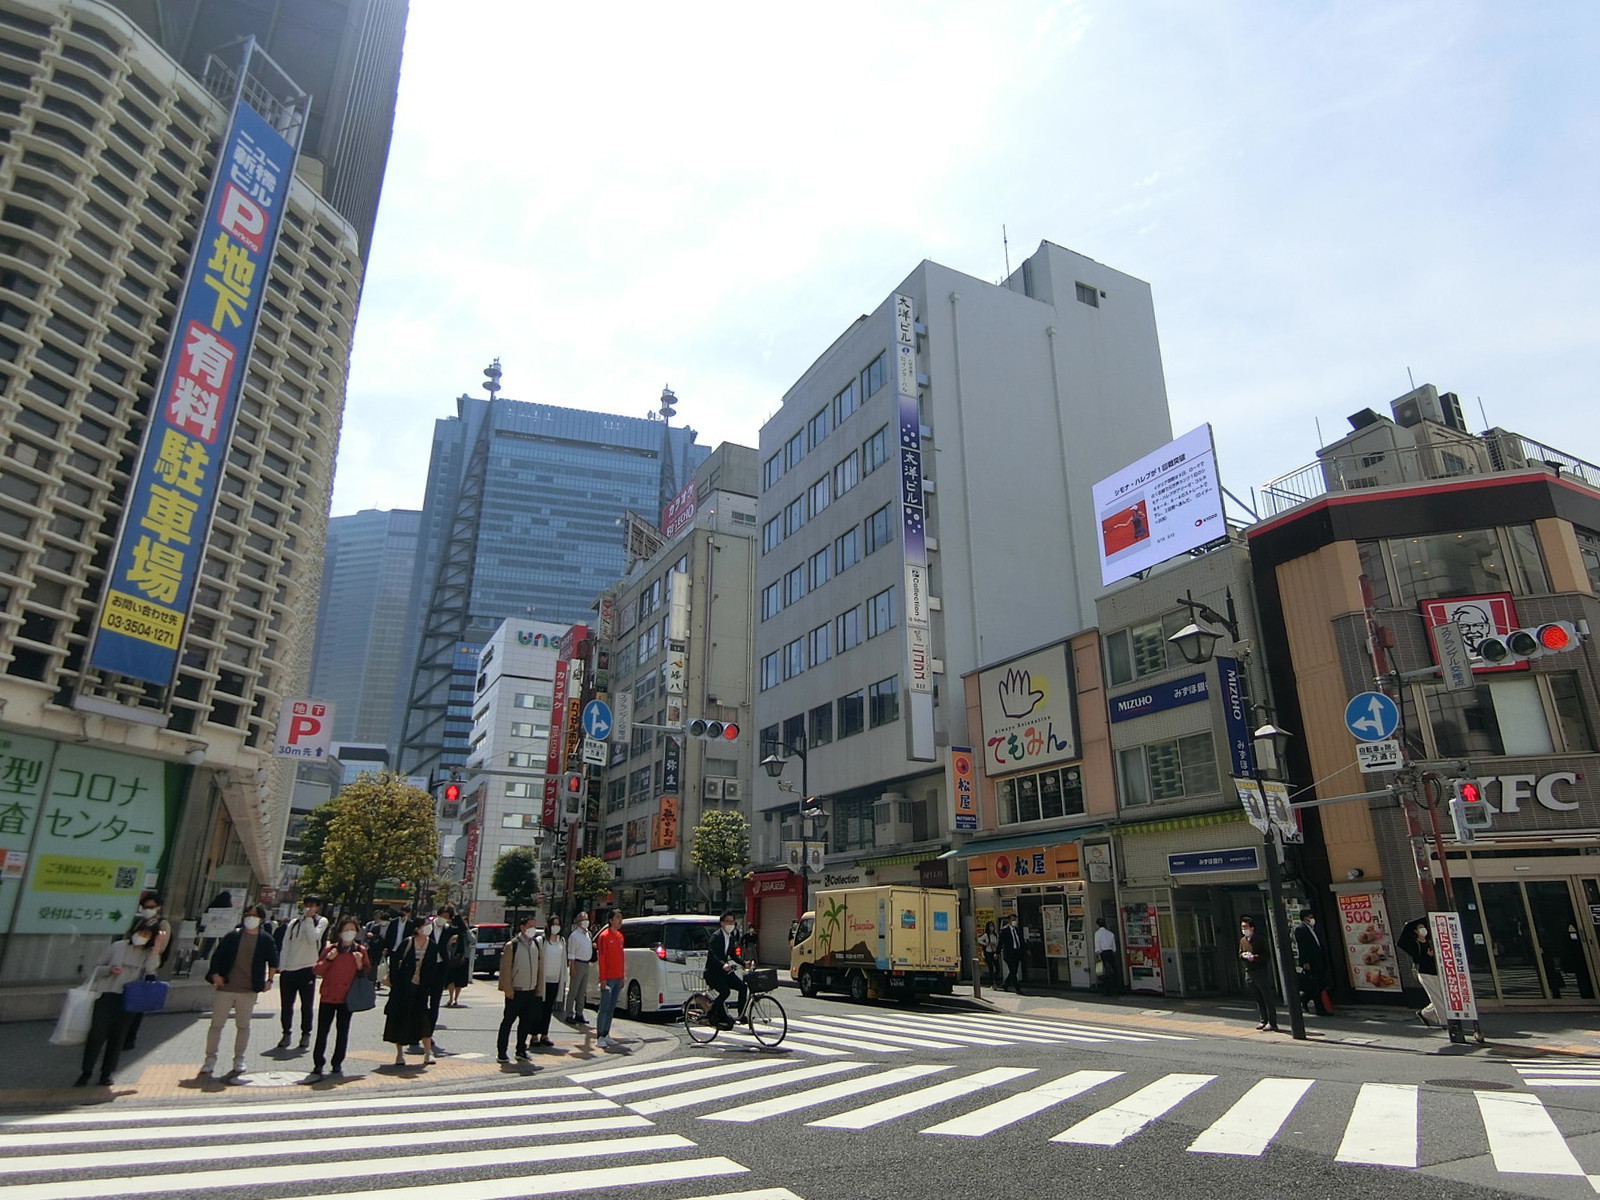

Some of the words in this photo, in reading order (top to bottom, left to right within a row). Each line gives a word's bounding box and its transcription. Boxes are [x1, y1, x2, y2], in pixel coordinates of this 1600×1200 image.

[236, 129, 281, 173] ニュー
[232, 144, 278, 194] 新橋
[230, 163, 273, 207] ビル
[112, 595, 178, 626] お問い合わせ先
[554, 670, 566, 709] カラオケ
[1117, 694, 1153, 712] MIZUHO
[1226, 668, 1242, 721] MIZUHO
[293, 702, 327, 717] 地下
[287, 716, 321, 745] P
[994, 725, 1015, 735] Always
[1017, 715, 1052, 728] Relaxation
[987, 722, 1068, 764] てもみん
[1360, 752, 1397, 762] 一方通行
[957, 777, 971, 810] 松屋
[1014, 853, 1046, 876] 松屋
[830, 875, 860, 885] Collection
[38, 906, 104, 921] 受付はこちら
